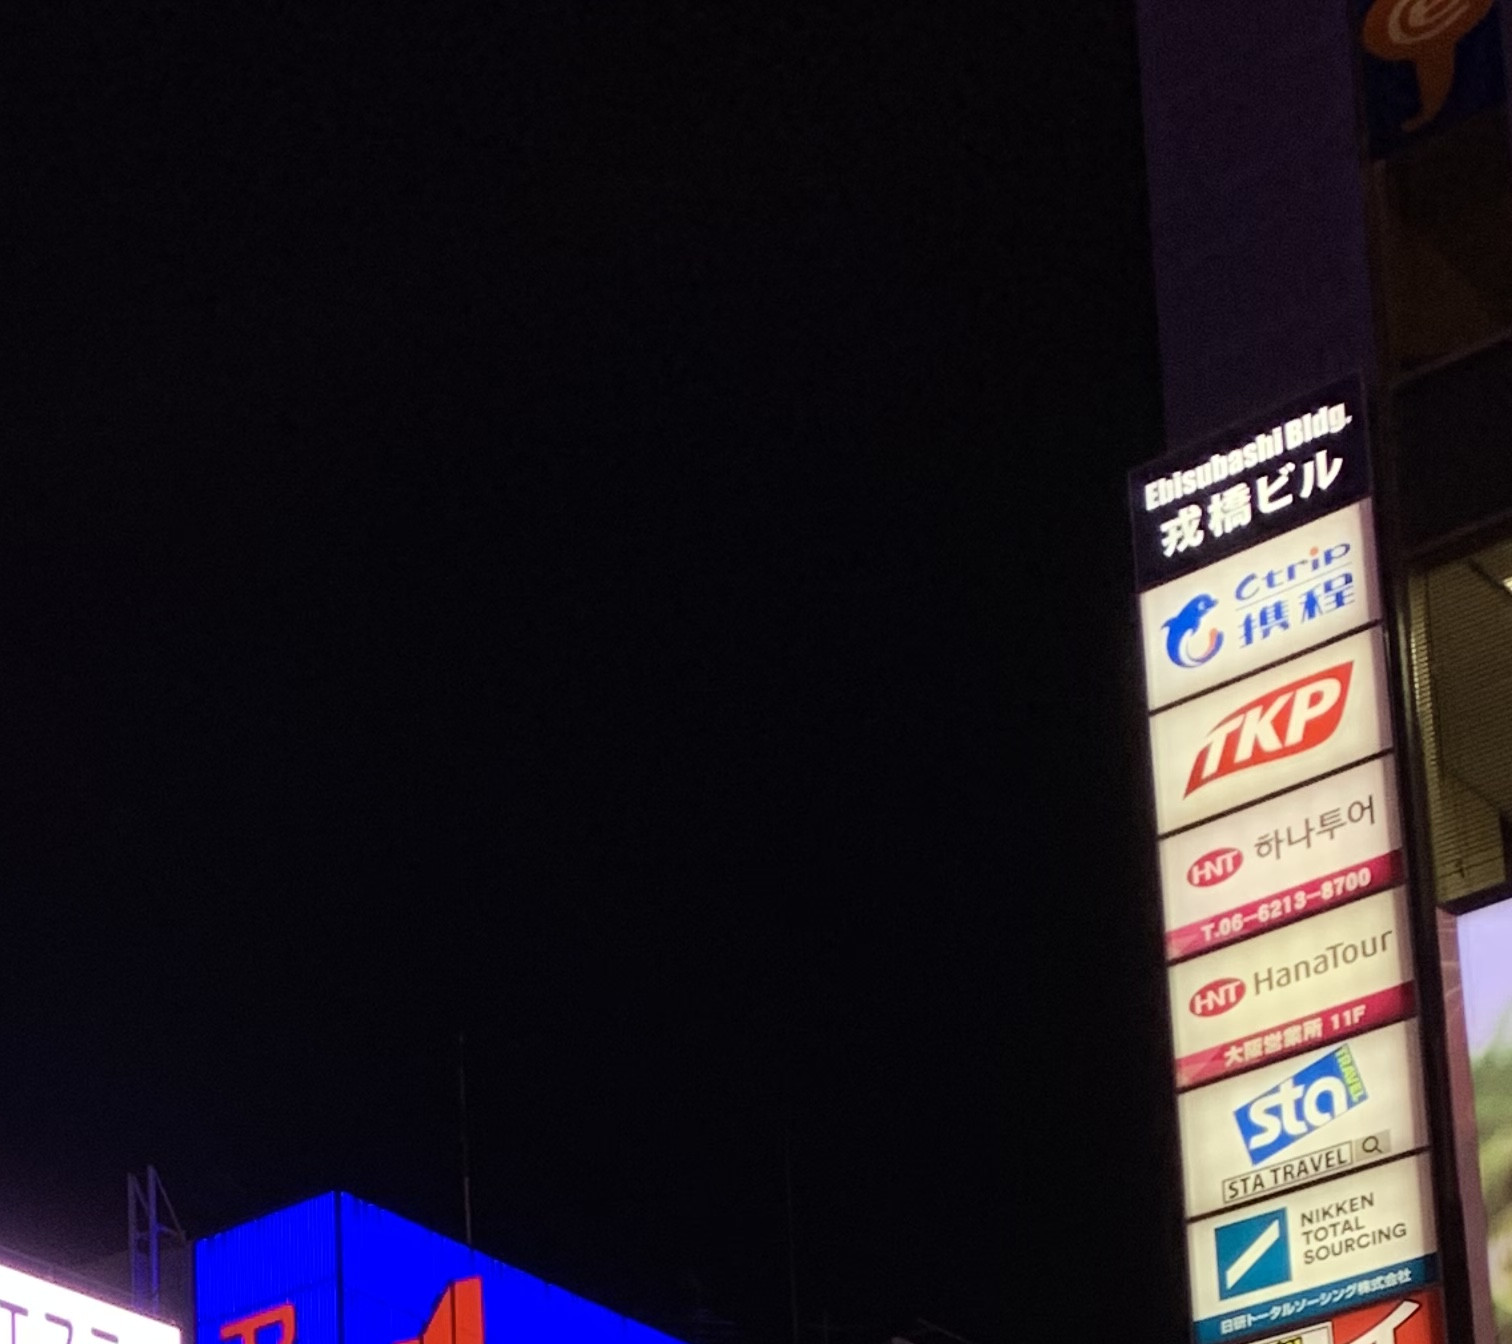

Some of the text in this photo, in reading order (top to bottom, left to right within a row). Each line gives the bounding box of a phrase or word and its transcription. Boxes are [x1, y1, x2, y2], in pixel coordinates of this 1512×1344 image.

[1144, 402, 1353, 511] Ebisubashi Bldg.
[1235, 540, 1352, 603] Ctrip
[1238, 572, 1356, 649] 携程
[1198, 677, 1341, 780] TKP
[1254, 794, 1377, 860] 하나투어
[1253, 930, 1393, 996] HanaTour
[1330, 1004, 1366, 1031] 11F
[1248, 1076, 1349, 1150] sta
[1228, 1148, 1348, 1200] STA TRAVEL
[1300, 1192, 1375, 1227] NIKKEN
[1302, 1214, 1366, 1245] TOTAL
[1304, 1222, 1408, 1265] SOURCING
